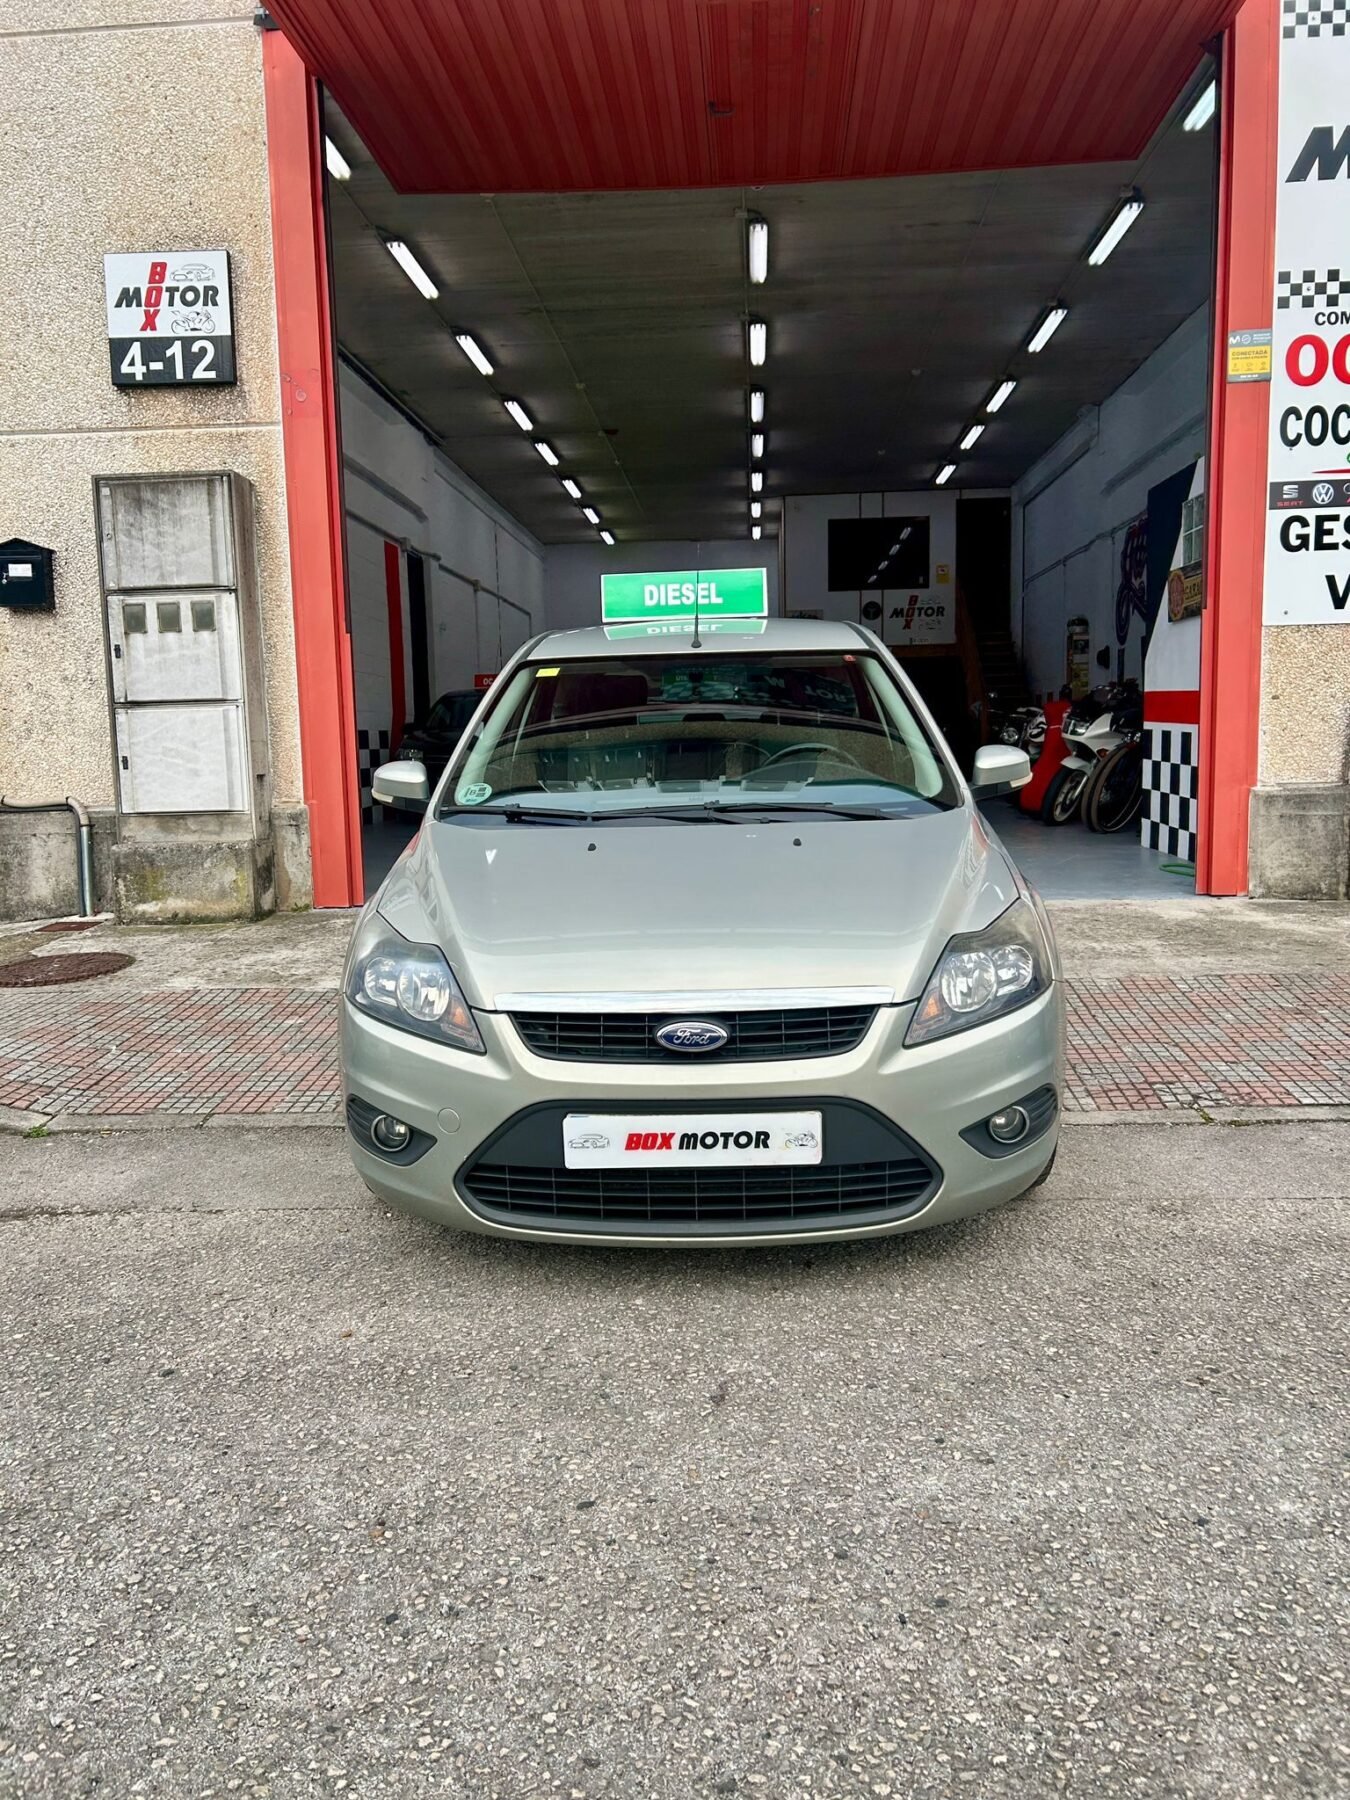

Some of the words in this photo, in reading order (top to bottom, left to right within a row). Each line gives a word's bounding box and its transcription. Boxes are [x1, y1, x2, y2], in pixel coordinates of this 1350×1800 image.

[114, 285, 219, 308] MOTOR
[140, 262, 167, 331] BOX
[120, 340, 217, 380] 4-12
[643, 583, 723, 606] DIESEL
[673, 1029, 710, 1044] Ford
[625, 1132, 676, 1150] BOX
[678, 1131, 770, 1150] MOTOR
